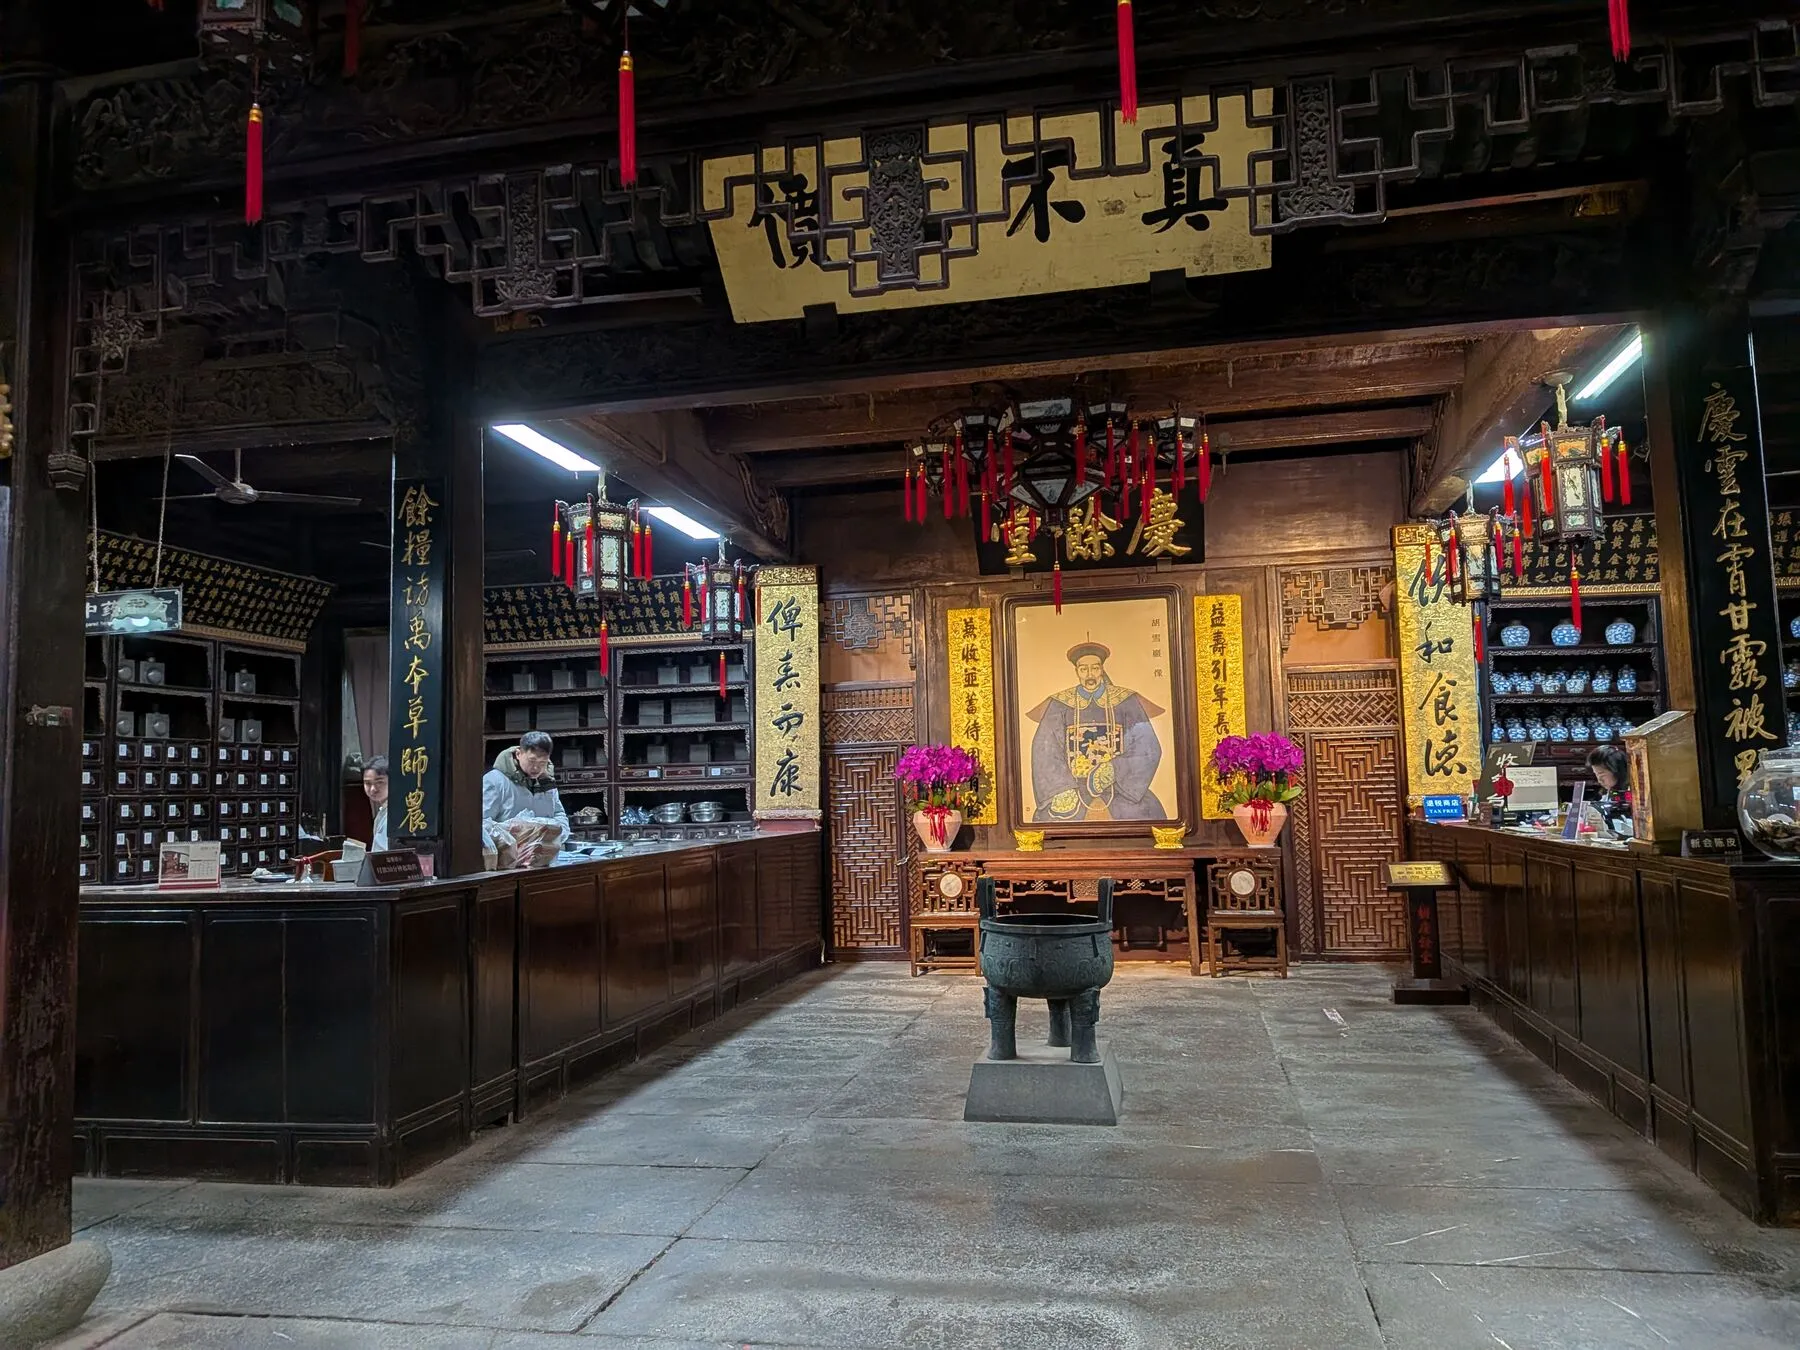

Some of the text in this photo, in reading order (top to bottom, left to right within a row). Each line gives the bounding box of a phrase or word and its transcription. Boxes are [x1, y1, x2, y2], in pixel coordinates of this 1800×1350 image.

[990, 487, 1193, 566] 慶餘堂
[1486, 753, 1520, 808] 收台
